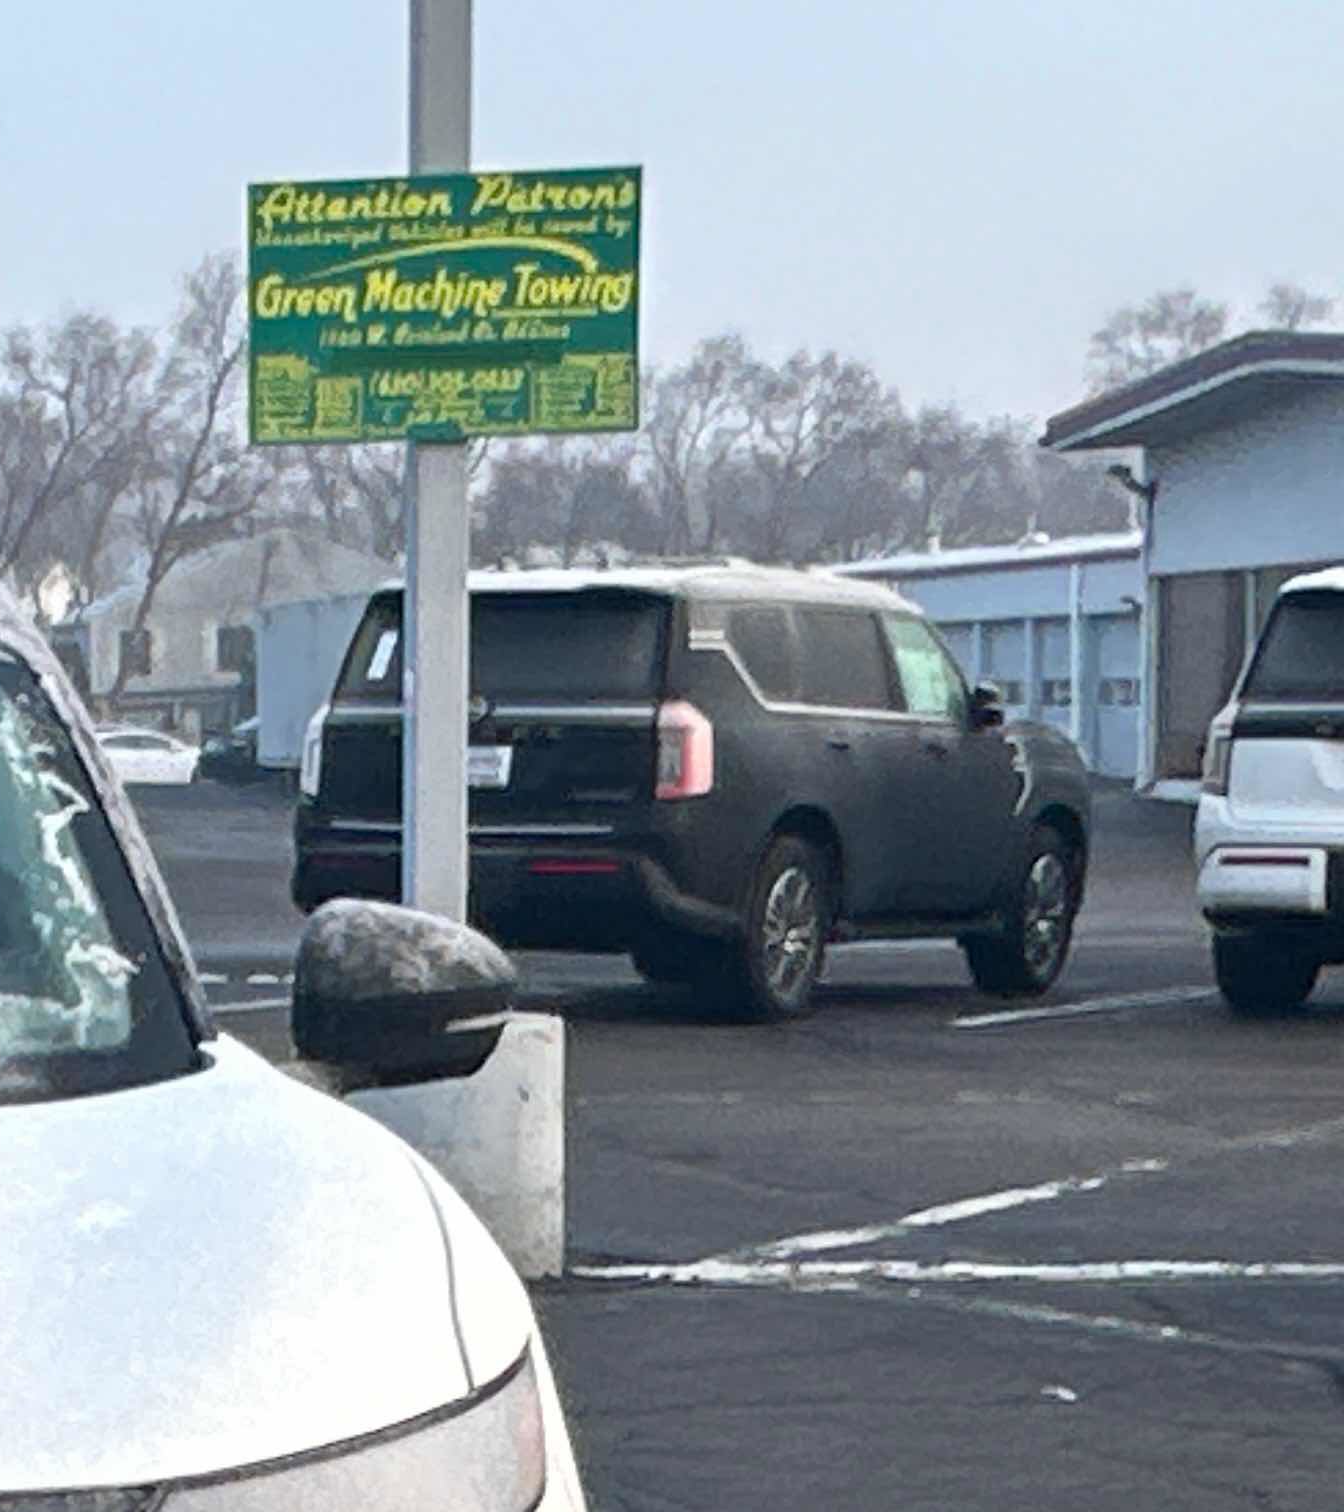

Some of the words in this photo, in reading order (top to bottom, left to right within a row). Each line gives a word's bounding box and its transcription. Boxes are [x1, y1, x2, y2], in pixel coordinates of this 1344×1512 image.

[256, 183, 452, 229] Attention
[470, 175, 635, 216] Patrons
[255, 273, 357, 323] Green
[363, 265, 507, 318] Machine
[513, 261, 633, 314] Towing
